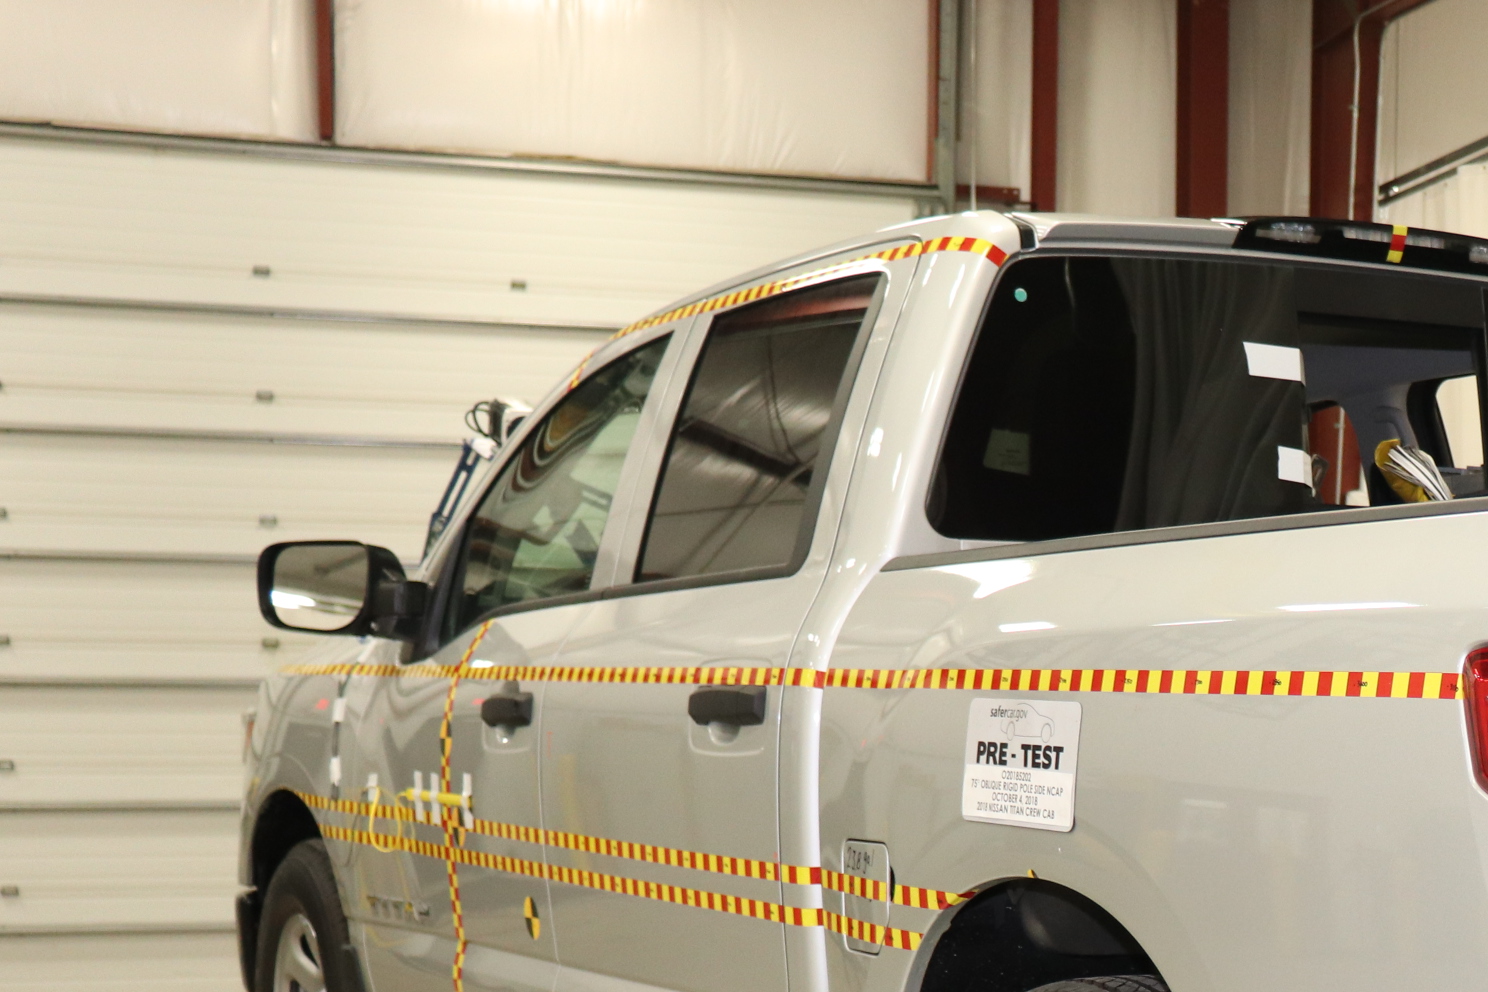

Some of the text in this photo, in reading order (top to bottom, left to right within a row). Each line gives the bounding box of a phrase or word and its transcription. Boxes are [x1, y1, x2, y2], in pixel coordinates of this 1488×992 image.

[990, 705, 1028, 721] safercar.gov
[1021, 743, 1064, 770] TEST
[981, 779, 1002, 790] OBLIQUE
[1003, 781, 1018, 792] RIGID
[1020, 783, 1033, 794] POLE
[1034, 784, 1045, 795] SIDE
[1046, 786, 1063, 797] NCAP
[992, 792, 1018, 803] OCTOBER
[1025, 795, 1038, 806] 2018
[989, 803, 1009, 814] NISSAN
[1010, 805, 1024, 815] TITAN
[1025, 807, 1041, 818] CREW
[1042, 808, 1055, 819] CAB
